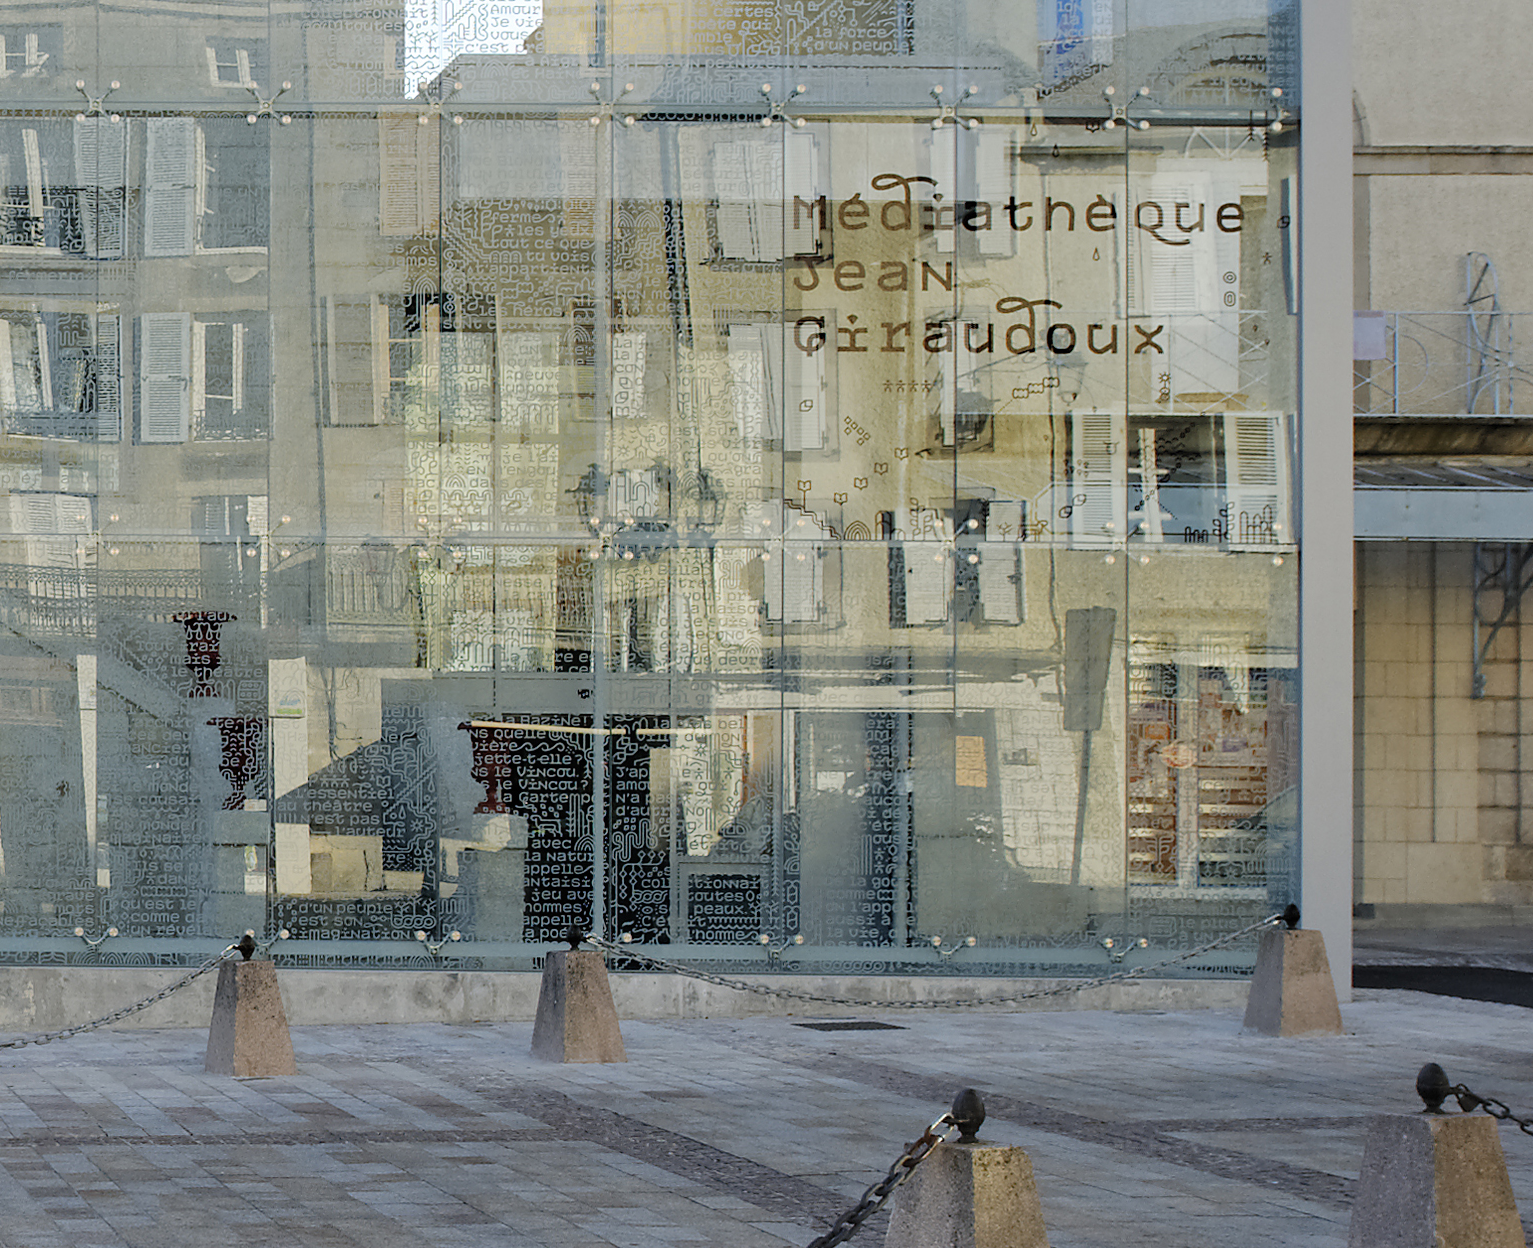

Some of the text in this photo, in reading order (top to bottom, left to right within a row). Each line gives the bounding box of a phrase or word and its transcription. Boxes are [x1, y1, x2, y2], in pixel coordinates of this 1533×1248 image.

[490, 4, 541, 15] Amour
[714, 6, 774, 17] certes
[490, 17, 509, 27] Je
[490, 31, 528, 40] vous
[815, 26, 889, 39] la force
[465, 43, 509, 53] c'est
[852, 40, 908, 54] peuple
[518, 225, 544, 236] les
[490, 238, 529, 249] tout
[534, 238, 554, 249] ce
[527, 250, 590, 261] tu vois
[480, 305, 563, 317] les héros
[793, 296, 1164, 357] Giraudoux
[170, 653, 211, 665] mais
[653, 717, 670, 729] la
[495, 766, 512, 777] le
[496, 779, 513, 790] le
[303, 800, 373, 811] théâtre
[350, 814, 381, 826] pas
[532, 839, 572, 849] avec
[531, 888, 562, 902] jeu
[336, 903, 393, 915] peuple
[299, 915, 329, 926] est
